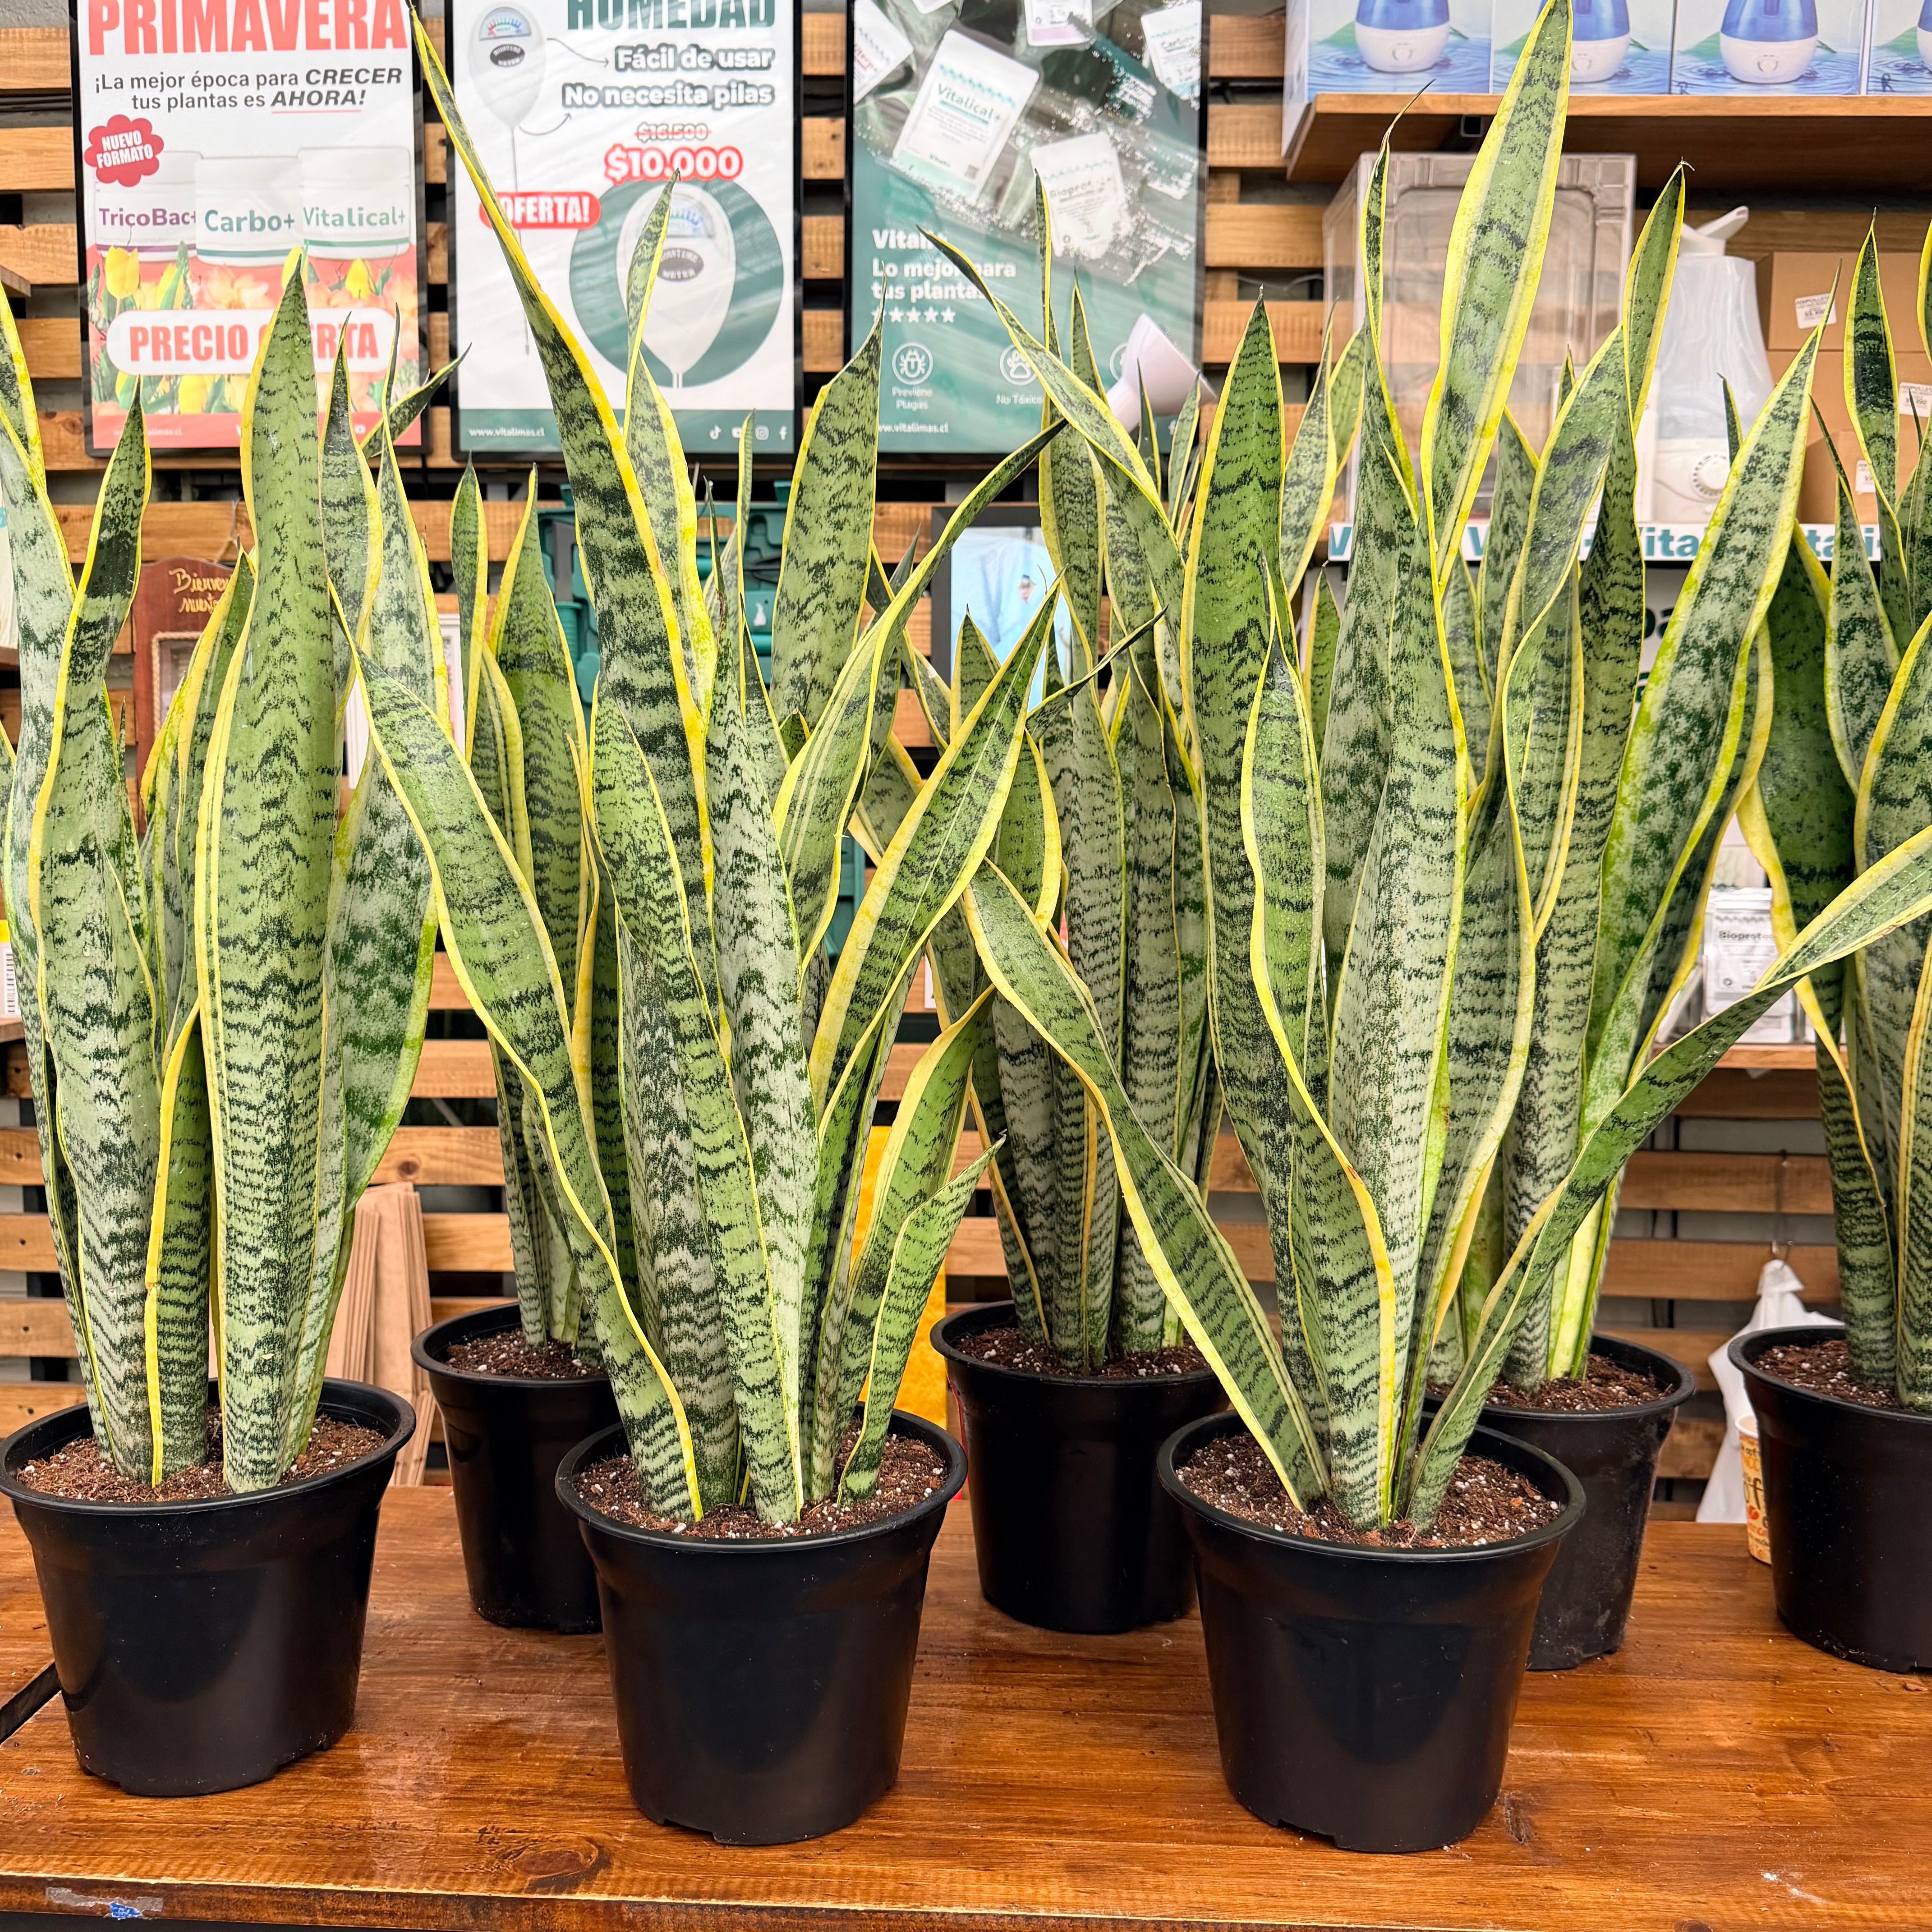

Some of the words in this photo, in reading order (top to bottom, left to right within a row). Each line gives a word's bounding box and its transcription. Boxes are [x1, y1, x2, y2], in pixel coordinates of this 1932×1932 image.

[90, 0, 407, 55] PRIMAVERA
[567, 0, 776, 30] HUMEDAD
[618, 44, 674, 69] Fácil
[680, 46, 711, 69] de
[718, 49, 773, 69] usar
[95, 74, 124, 92] ¡La
[130, 73, 185, 92] mejor
[191, 70, 249, 91] época
[256, 72, 299, 87] para
[305, 68, 403, 85] CRECER
[131, 93, 161, 110] tus
[167, 92, 238, 112] plantas
[244, 94, 266, 108] es
[271, 89, 366, 106] AHORA!
[564, 85, 600, 107] No
[604, 81, 708, 106] necesita
[714, 80, 773, 108] pilas
[101, 129, 143, 152] NUEVO
[96, 143, 153, 169] FORMATO
[606, 146, 741, 182] $10.000
[204, 209, 295, 233] Carbo+
[303, 206, 405, 227] Vitalical+
[872, 258, 898, 277] Lo
[975, 263, 1016, 277] ara
[129, 324, 248, 362] PRECIO
[892, 386, 933, 398] Previene
[996, 394, 1011, 405] No
[896, 399, 929, 411] Plagas
